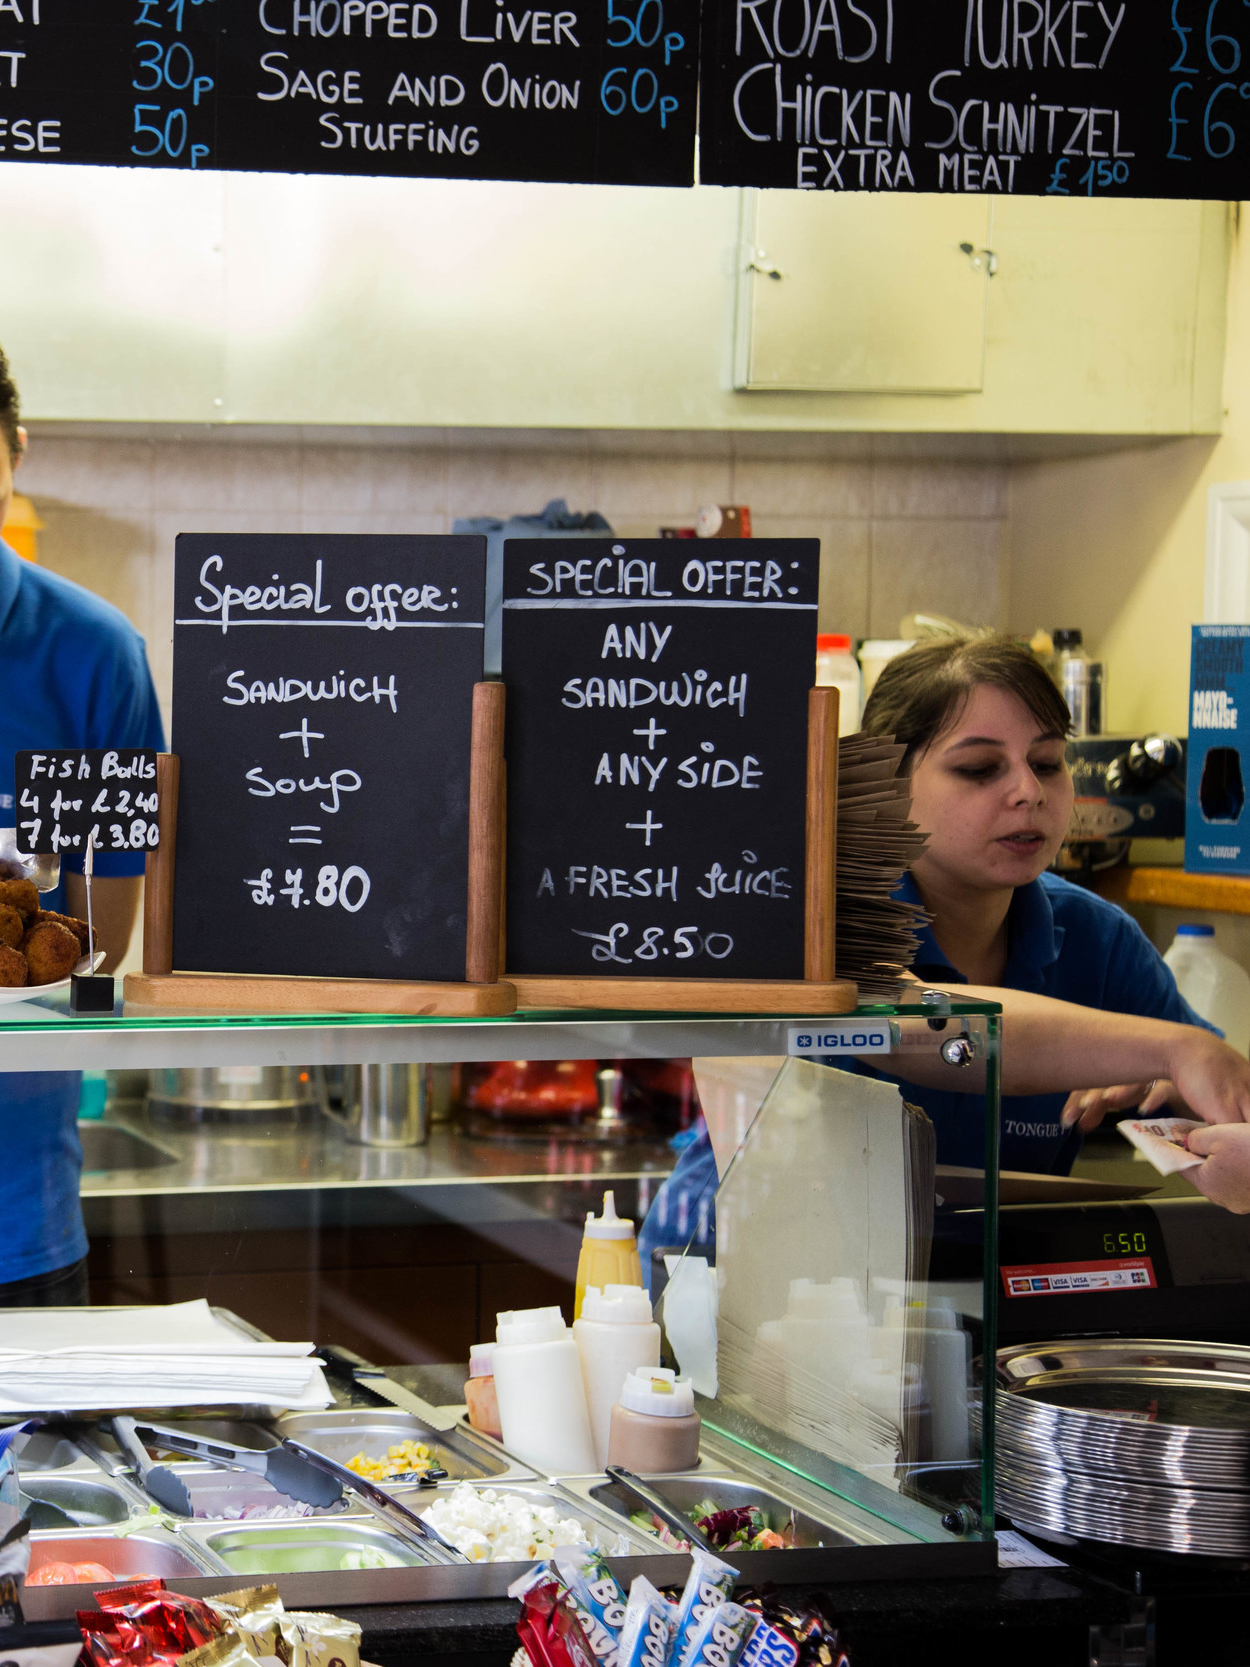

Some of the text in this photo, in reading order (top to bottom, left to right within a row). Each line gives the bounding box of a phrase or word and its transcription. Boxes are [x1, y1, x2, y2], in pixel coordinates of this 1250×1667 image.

[259, 0, 684, 65] CHOPPED LIVER 50p
[735, 0, 1250, 74] ROAST TURKEY £6
[133, 41, 214, 105] 30p
[257, 52, 678, 128] SAGE AND ONION 60p
[734, 63, 911, 147] CHICKEN
[925, 70, 1134, 157] SCHNITZEL
[131, 105, 209, 168] 50p
[320, 113, 479, 155] STUFFING
[797, 147, 915, 190] EXTRA
[939, 153, 1020, 192] MEAT
[527, 545, 799, 597] SPECIAL OFFER:
[194, 554, 459, 635] Special offer:
[602, 622, 672, 662] ANY
[223, 670, 398, 713] SANDWICH
[562, 669, 747, 717] SANDWICH
[1192, 707, 1238, 730] NNAISE
[31, 751, 155, 779] Fish Balls
[595, 742, 763, 791] ANY SIDE
[20, 788, 39, 813] 4
[50, 790, 82, 820] for
[246, 767, 361, 813] Soup
[20, 818, 42, 848] 7
[51, 824, 81, 853] for
[244, 865, 371, 912] £7.80
[538, 850, 791, 901] A FRESH JUICE
[571, 922, 734, 964] £8.50
[817, 1033, 884, 1048] IGLOO
[1005, 1119, 1058, 1138] TONGUE
[1053, 1278, 1068, 1286] VISA
[1073, 1276, 1088, 1284] VISA
